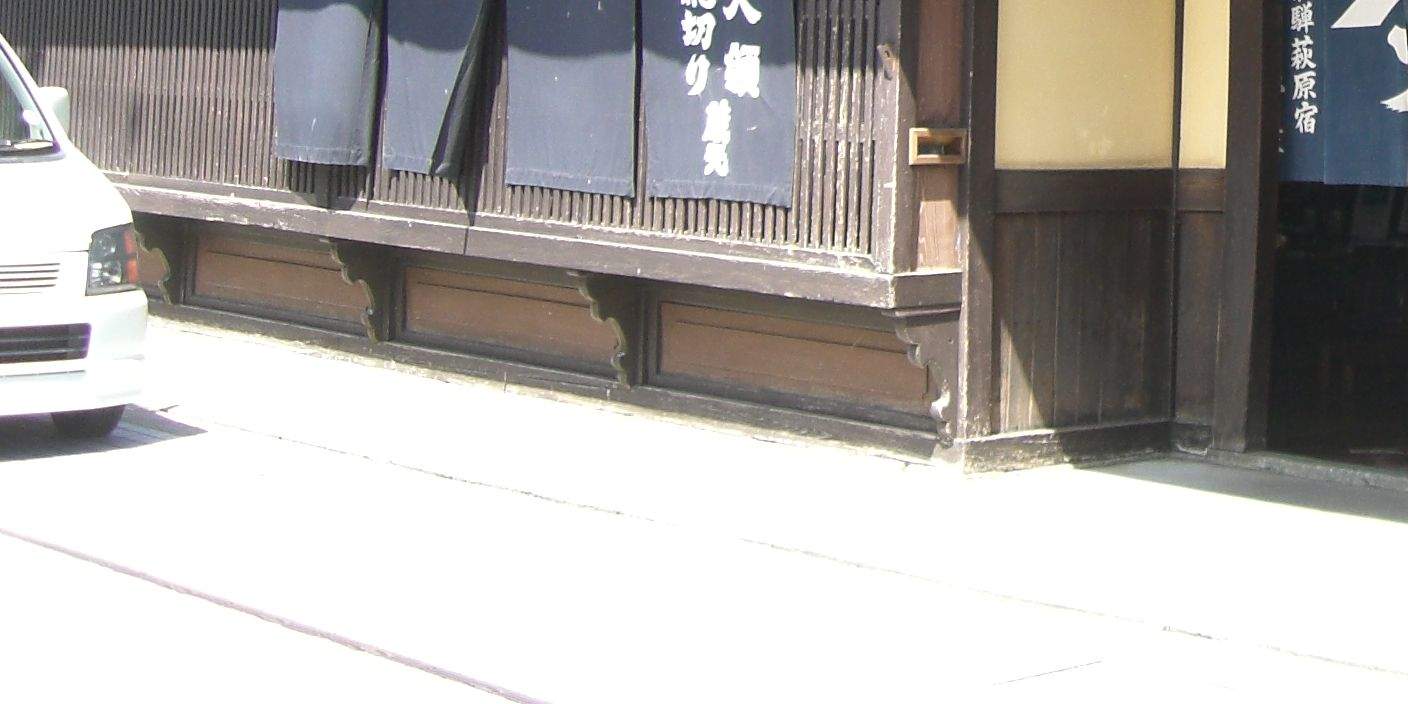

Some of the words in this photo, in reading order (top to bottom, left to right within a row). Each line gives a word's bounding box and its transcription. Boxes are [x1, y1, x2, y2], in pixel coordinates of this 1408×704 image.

[681, 0, 717, 96] 切り
[1290, 0, 1319, 134] 騨萩原宿
